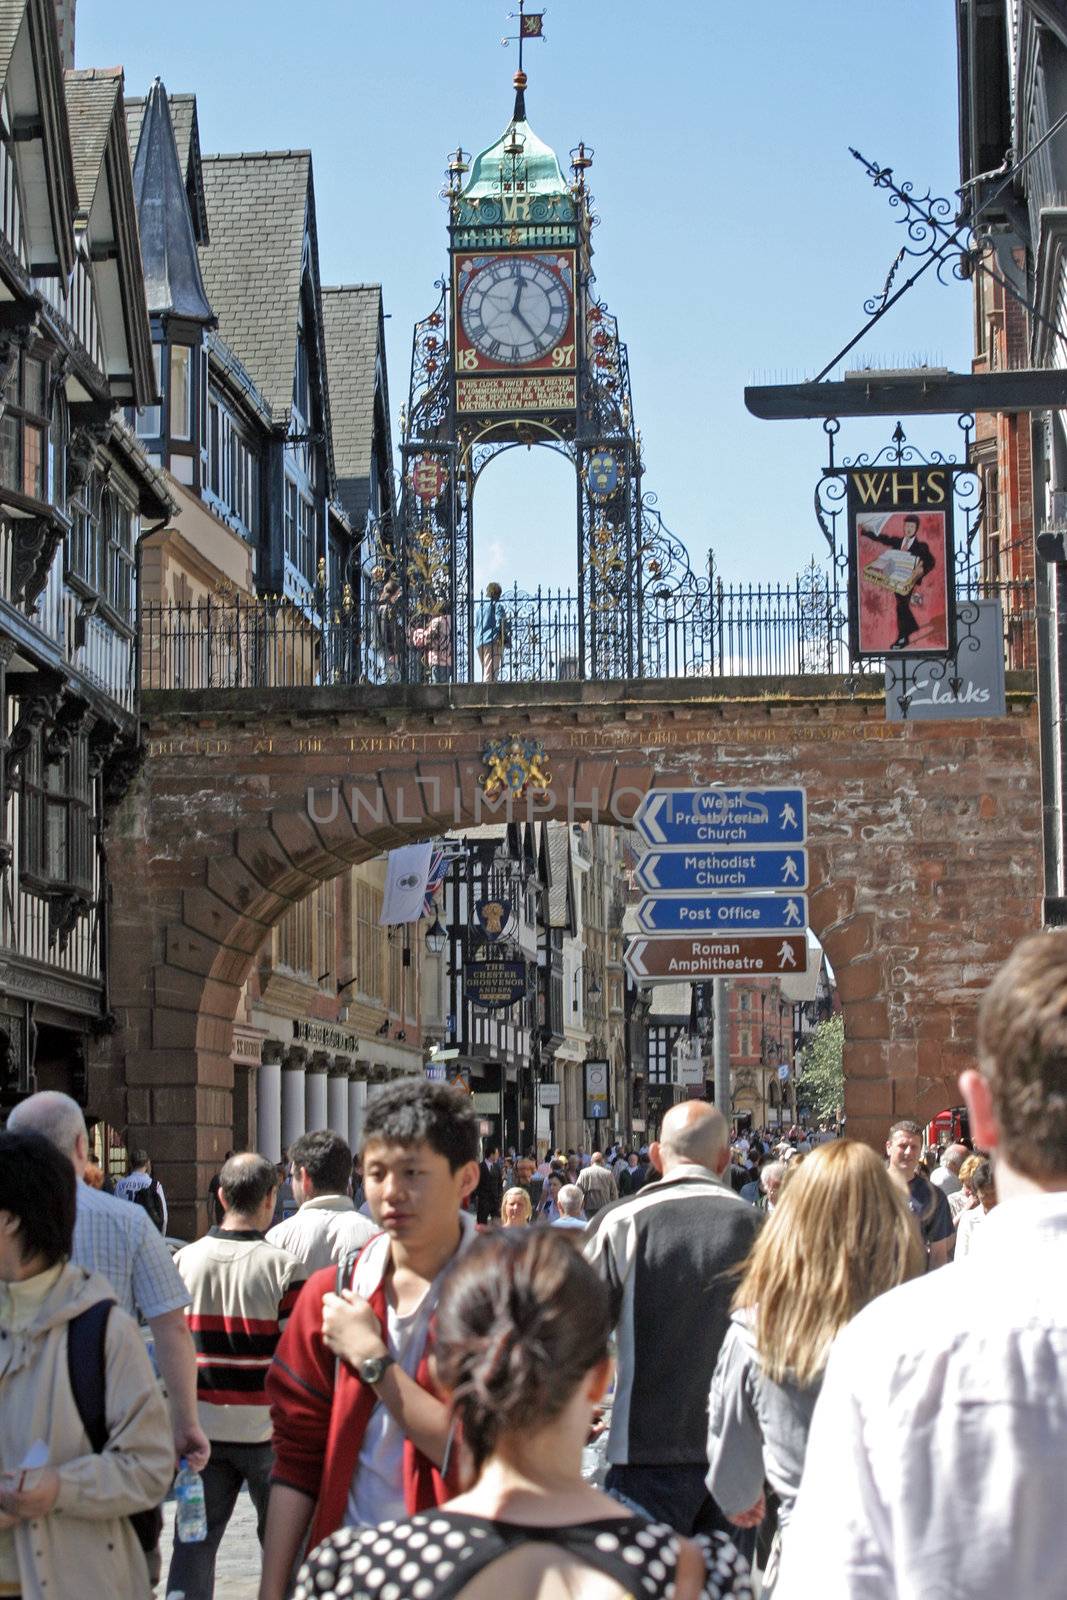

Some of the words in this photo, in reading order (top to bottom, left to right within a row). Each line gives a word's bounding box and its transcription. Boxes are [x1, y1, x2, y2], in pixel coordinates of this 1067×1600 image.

[457, 349, 479, 370] 18
[552, 344, 575, 368] 97
[460, 401, 496, 410] VICTORIA
[524, 400, 538, 408] AND
[539, 399, 574, 408] EMPRESS
[702, 796, 743, 809] Welsh
[675, 811, 769, 826] Presbyterian
[697, 827, 747, 840] Church
[684, 856, 756, 870] Methodist
[695, 872, 746, 885] Church
[679, 907, 712, 920] Post
[718, 906, 761, 920] Office
[692, 942, 740, 955] Roman
[485, 963, 505, 971] THE
[668, 957, 764, 972] Amphitheatre
